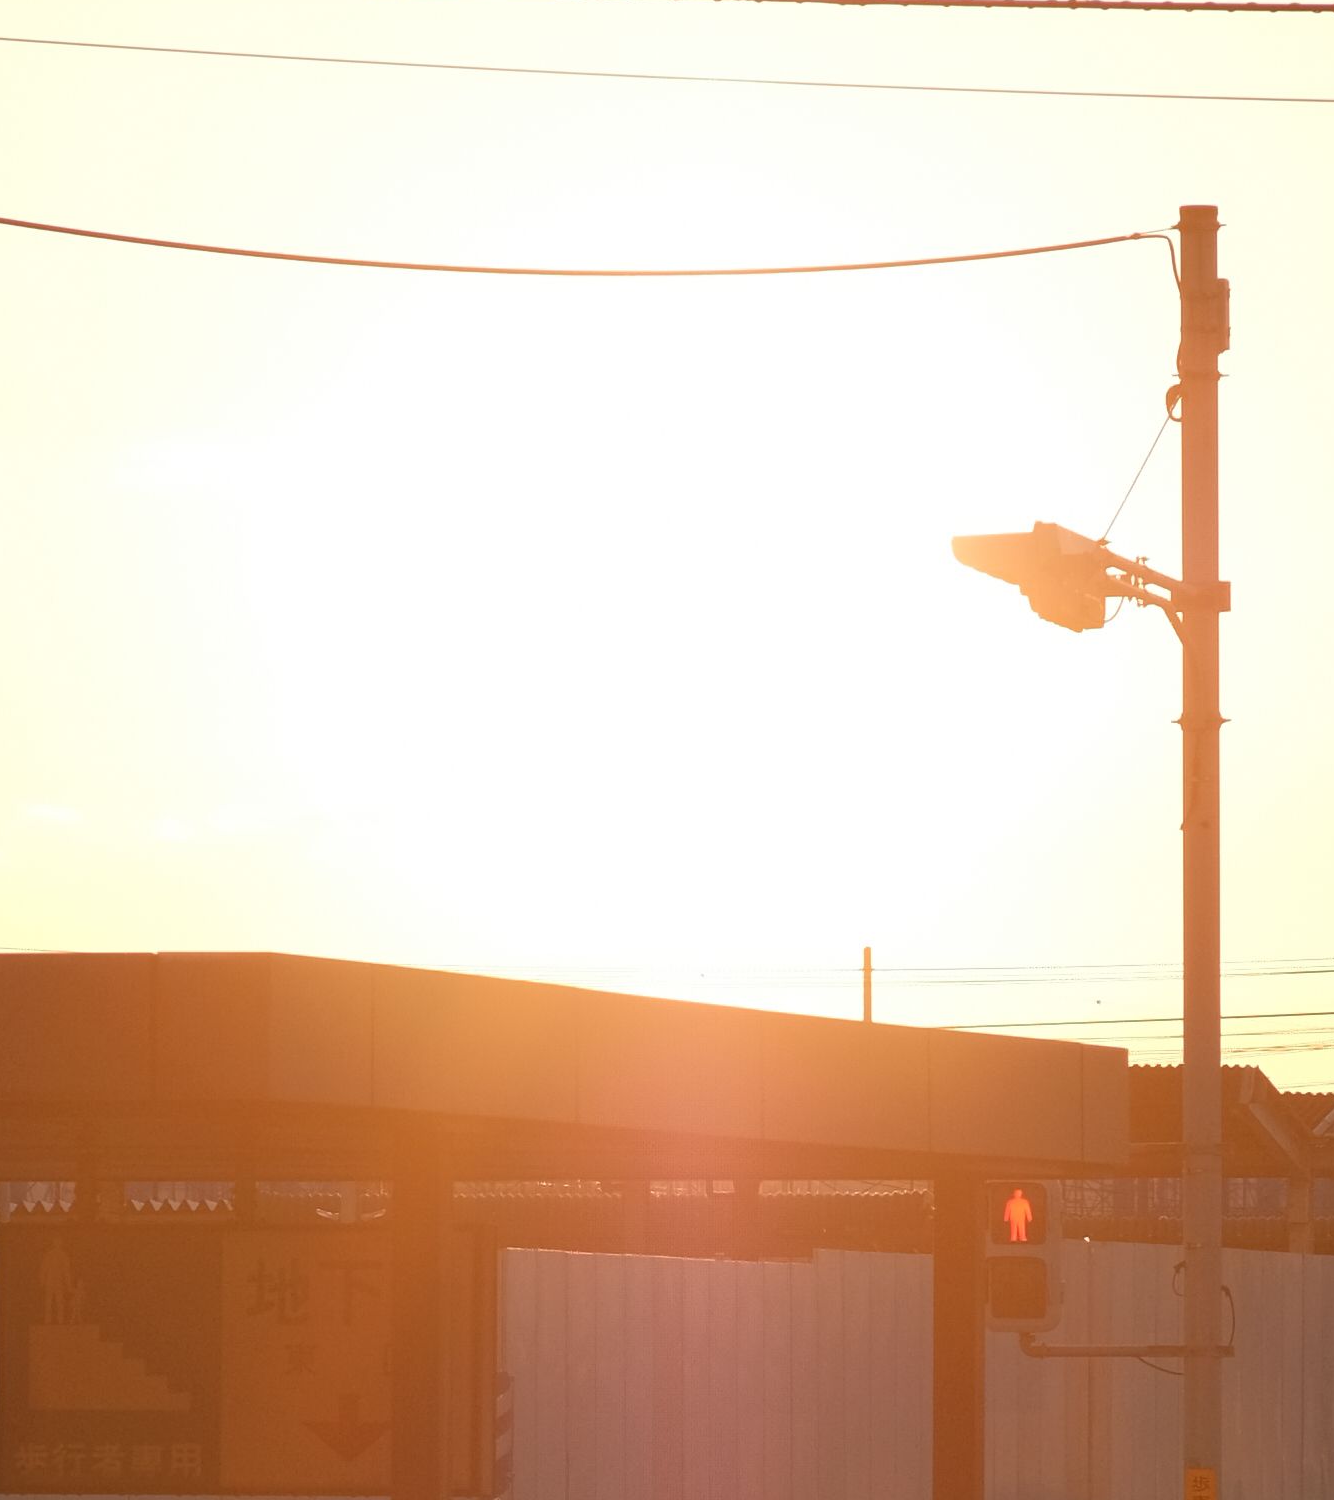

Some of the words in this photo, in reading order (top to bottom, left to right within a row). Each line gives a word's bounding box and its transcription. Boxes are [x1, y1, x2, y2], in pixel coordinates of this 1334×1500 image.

[14, 1442, 203, 1478] 歩行者専用
